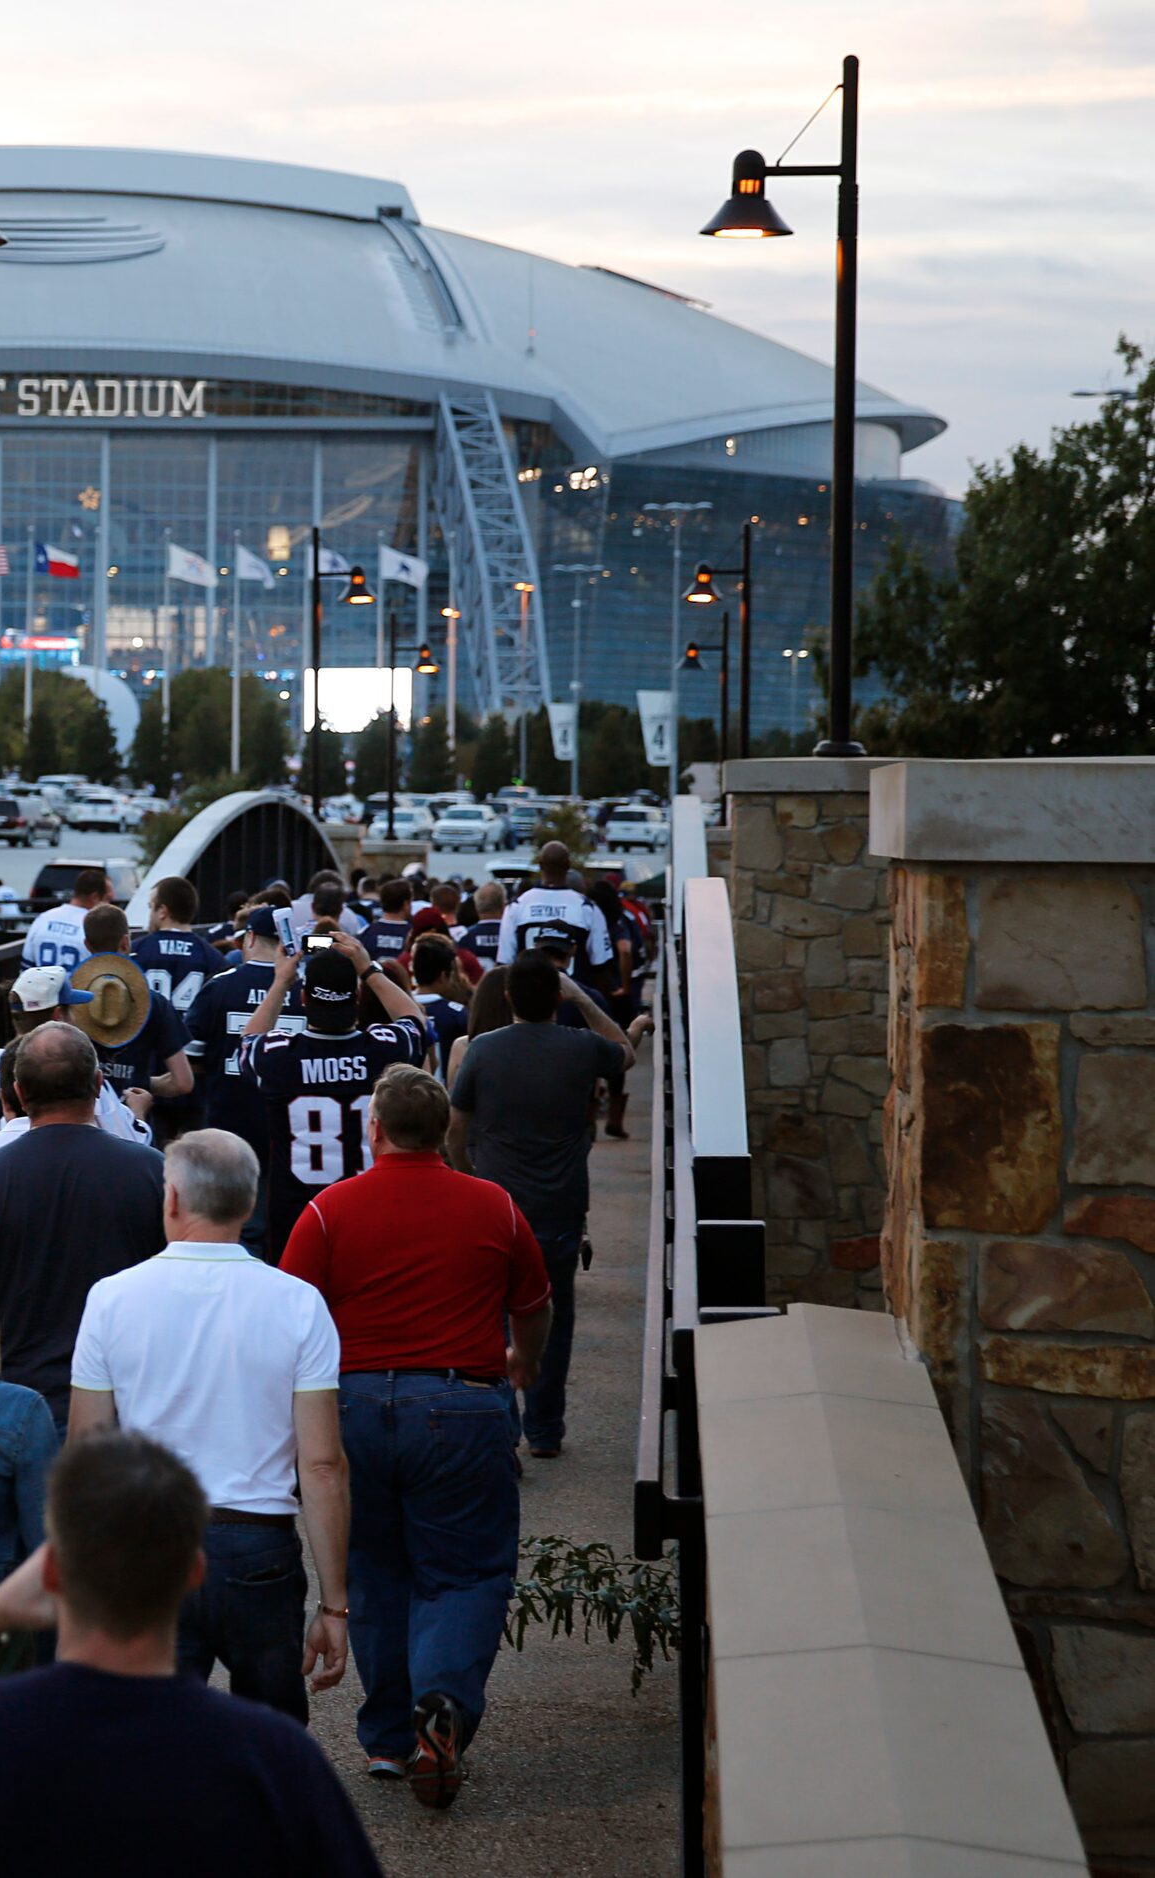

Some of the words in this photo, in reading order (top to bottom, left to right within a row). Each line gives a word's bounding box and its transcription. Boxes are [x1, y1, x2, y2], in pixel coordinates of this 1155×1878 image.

[18, 379, 207, 418] STADIUM
[652, 724, 665, 750] 4
[158, 939, 194, 956] WARE
[300, 1056, 367, 1084] MOSS
